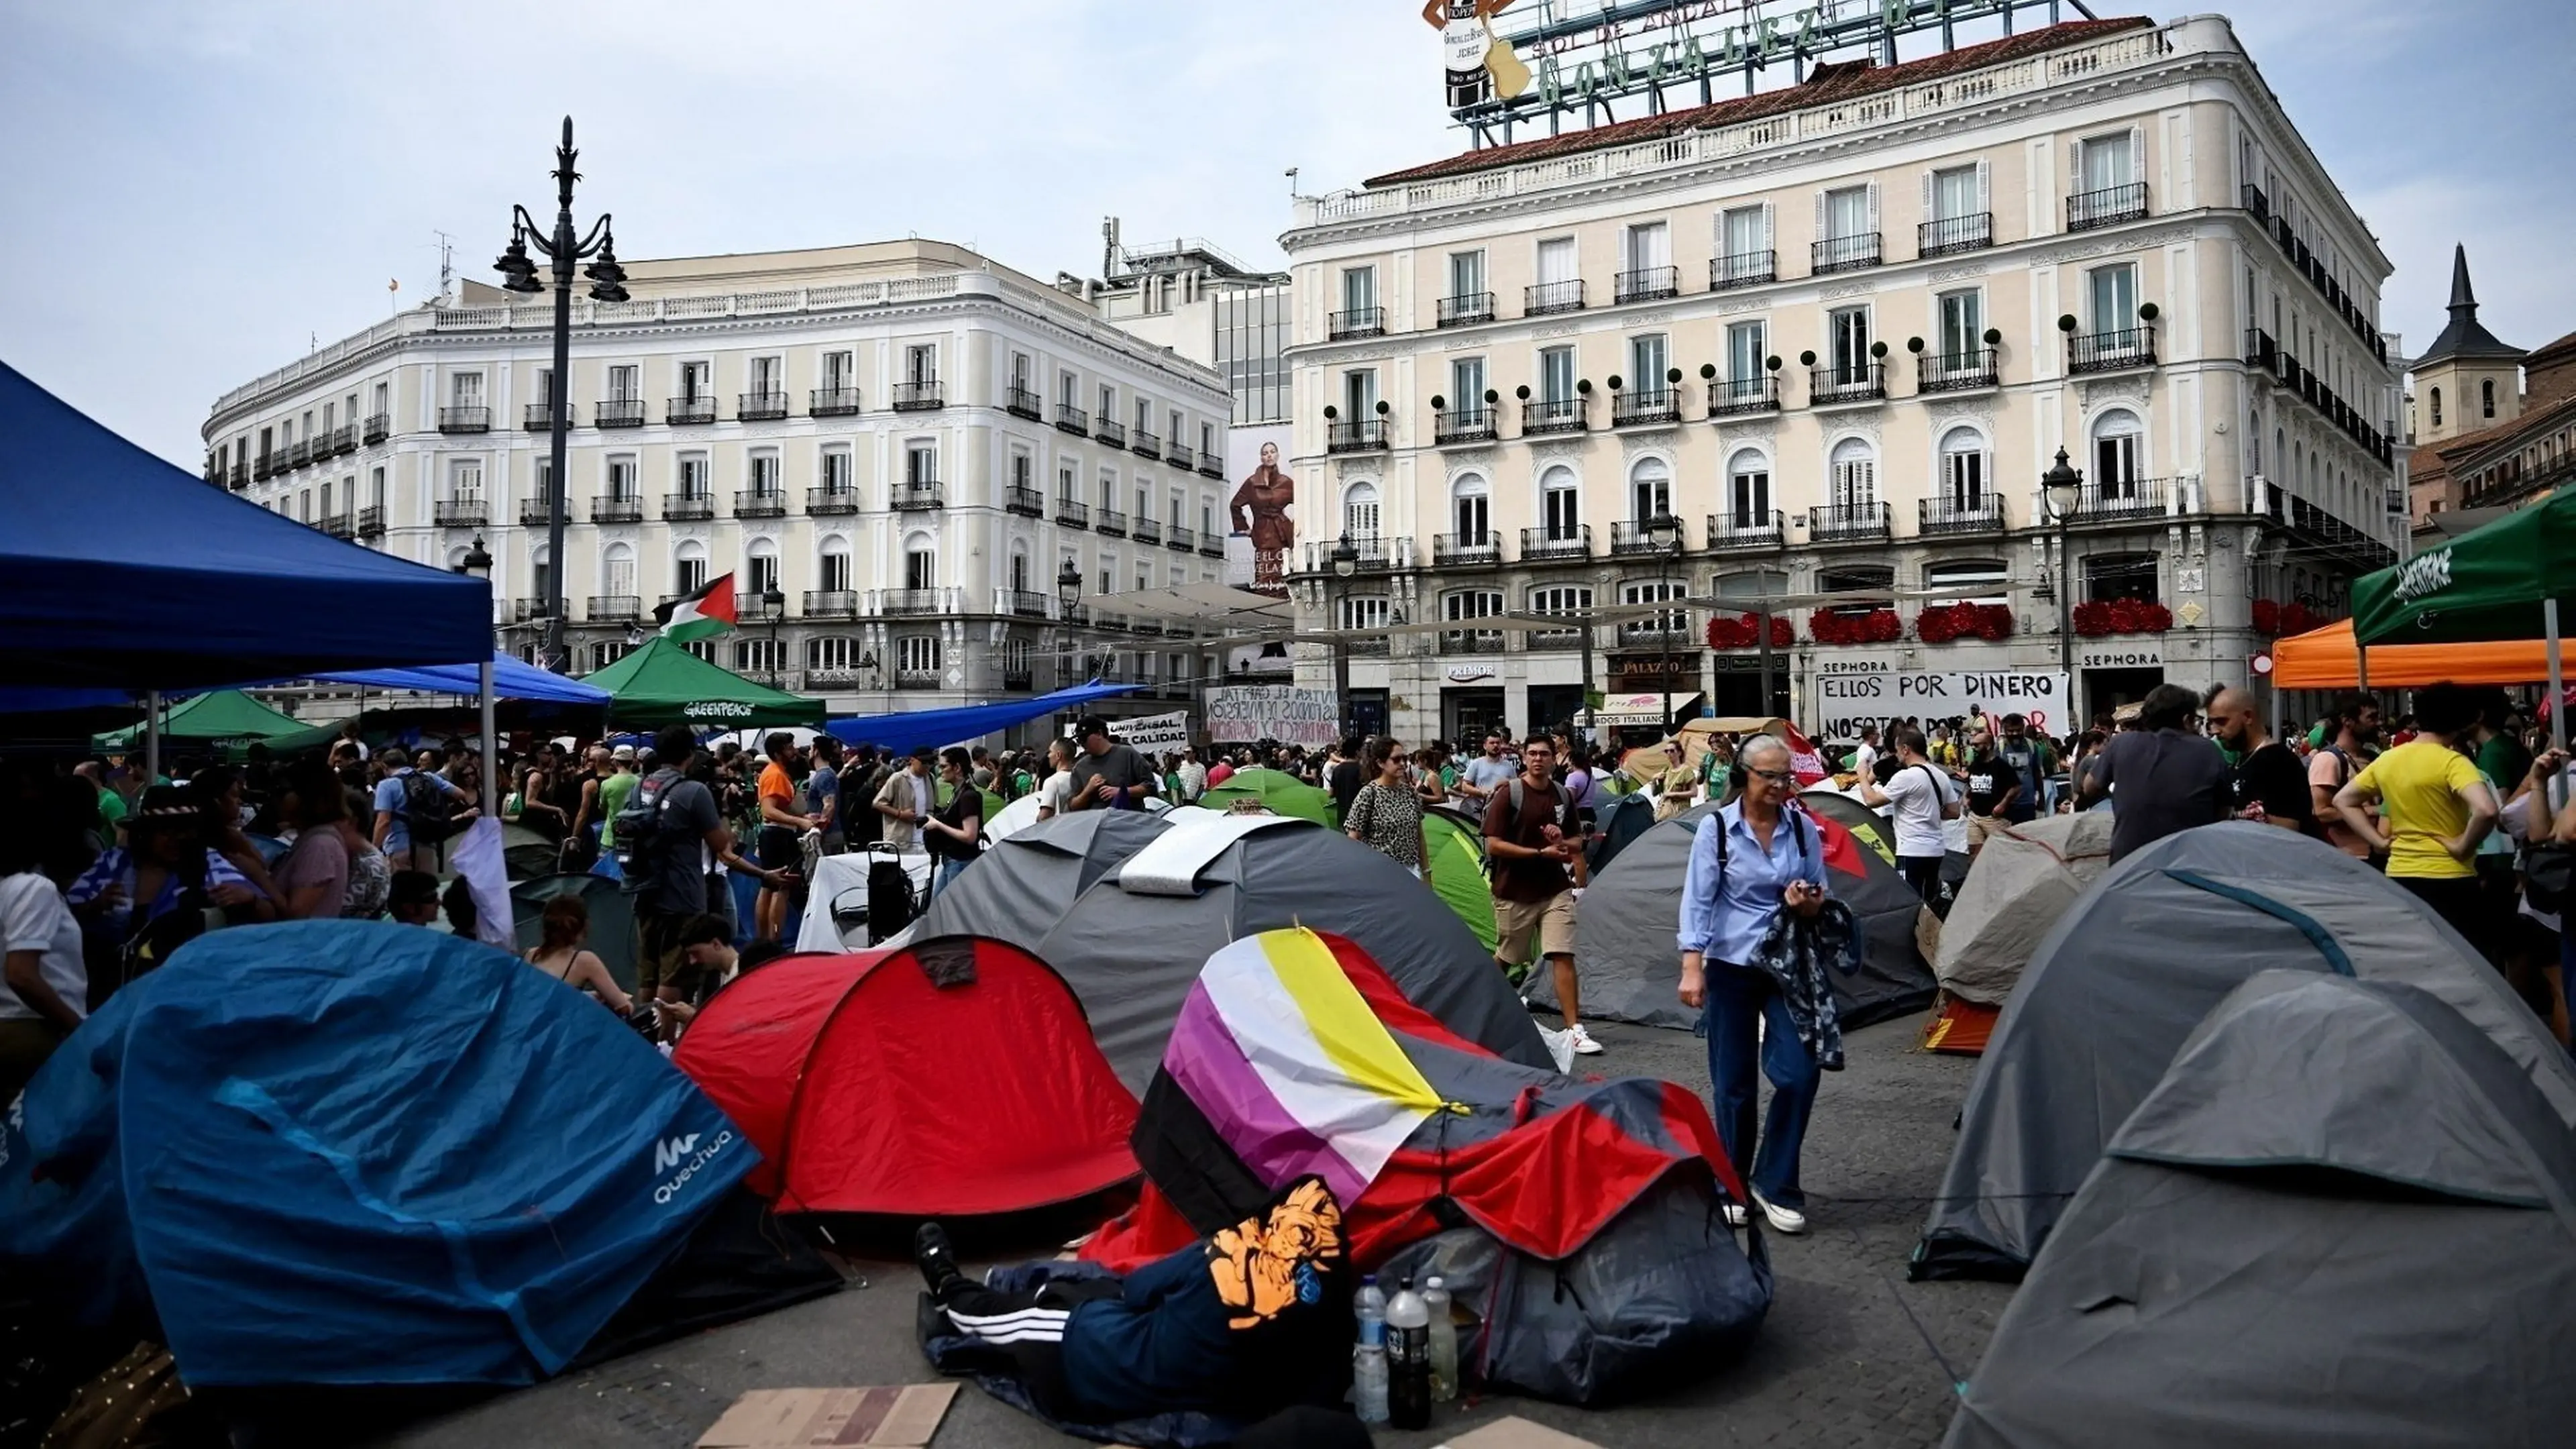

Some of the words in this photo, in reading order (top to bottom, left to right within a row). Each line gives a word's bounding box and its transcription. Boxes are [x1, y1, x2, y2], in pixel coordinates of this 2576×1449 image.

[1538, 7, 1817, 106] GONZALEZ
[2084, 653, 2159, 666] SEPHORA
[1449, 665, 1495, 676] PRIMOR
[1623, 661, 1679, 674] PALAZO
[1823, 661, 1888, 673] SEPHORA
[1825, 676, 1882, 698] ELLOS
[1899, 675, 1947, 698] POR
[684, 702, 755, 717] GREENPEACE
[1577, 715, 1619, 724] HADOS
[1623, 715, 1665, 724] ITALIANO
[1132, 731, 1186, 745] CALIDAD
[654, 1130, 733, 1204] Quechua
